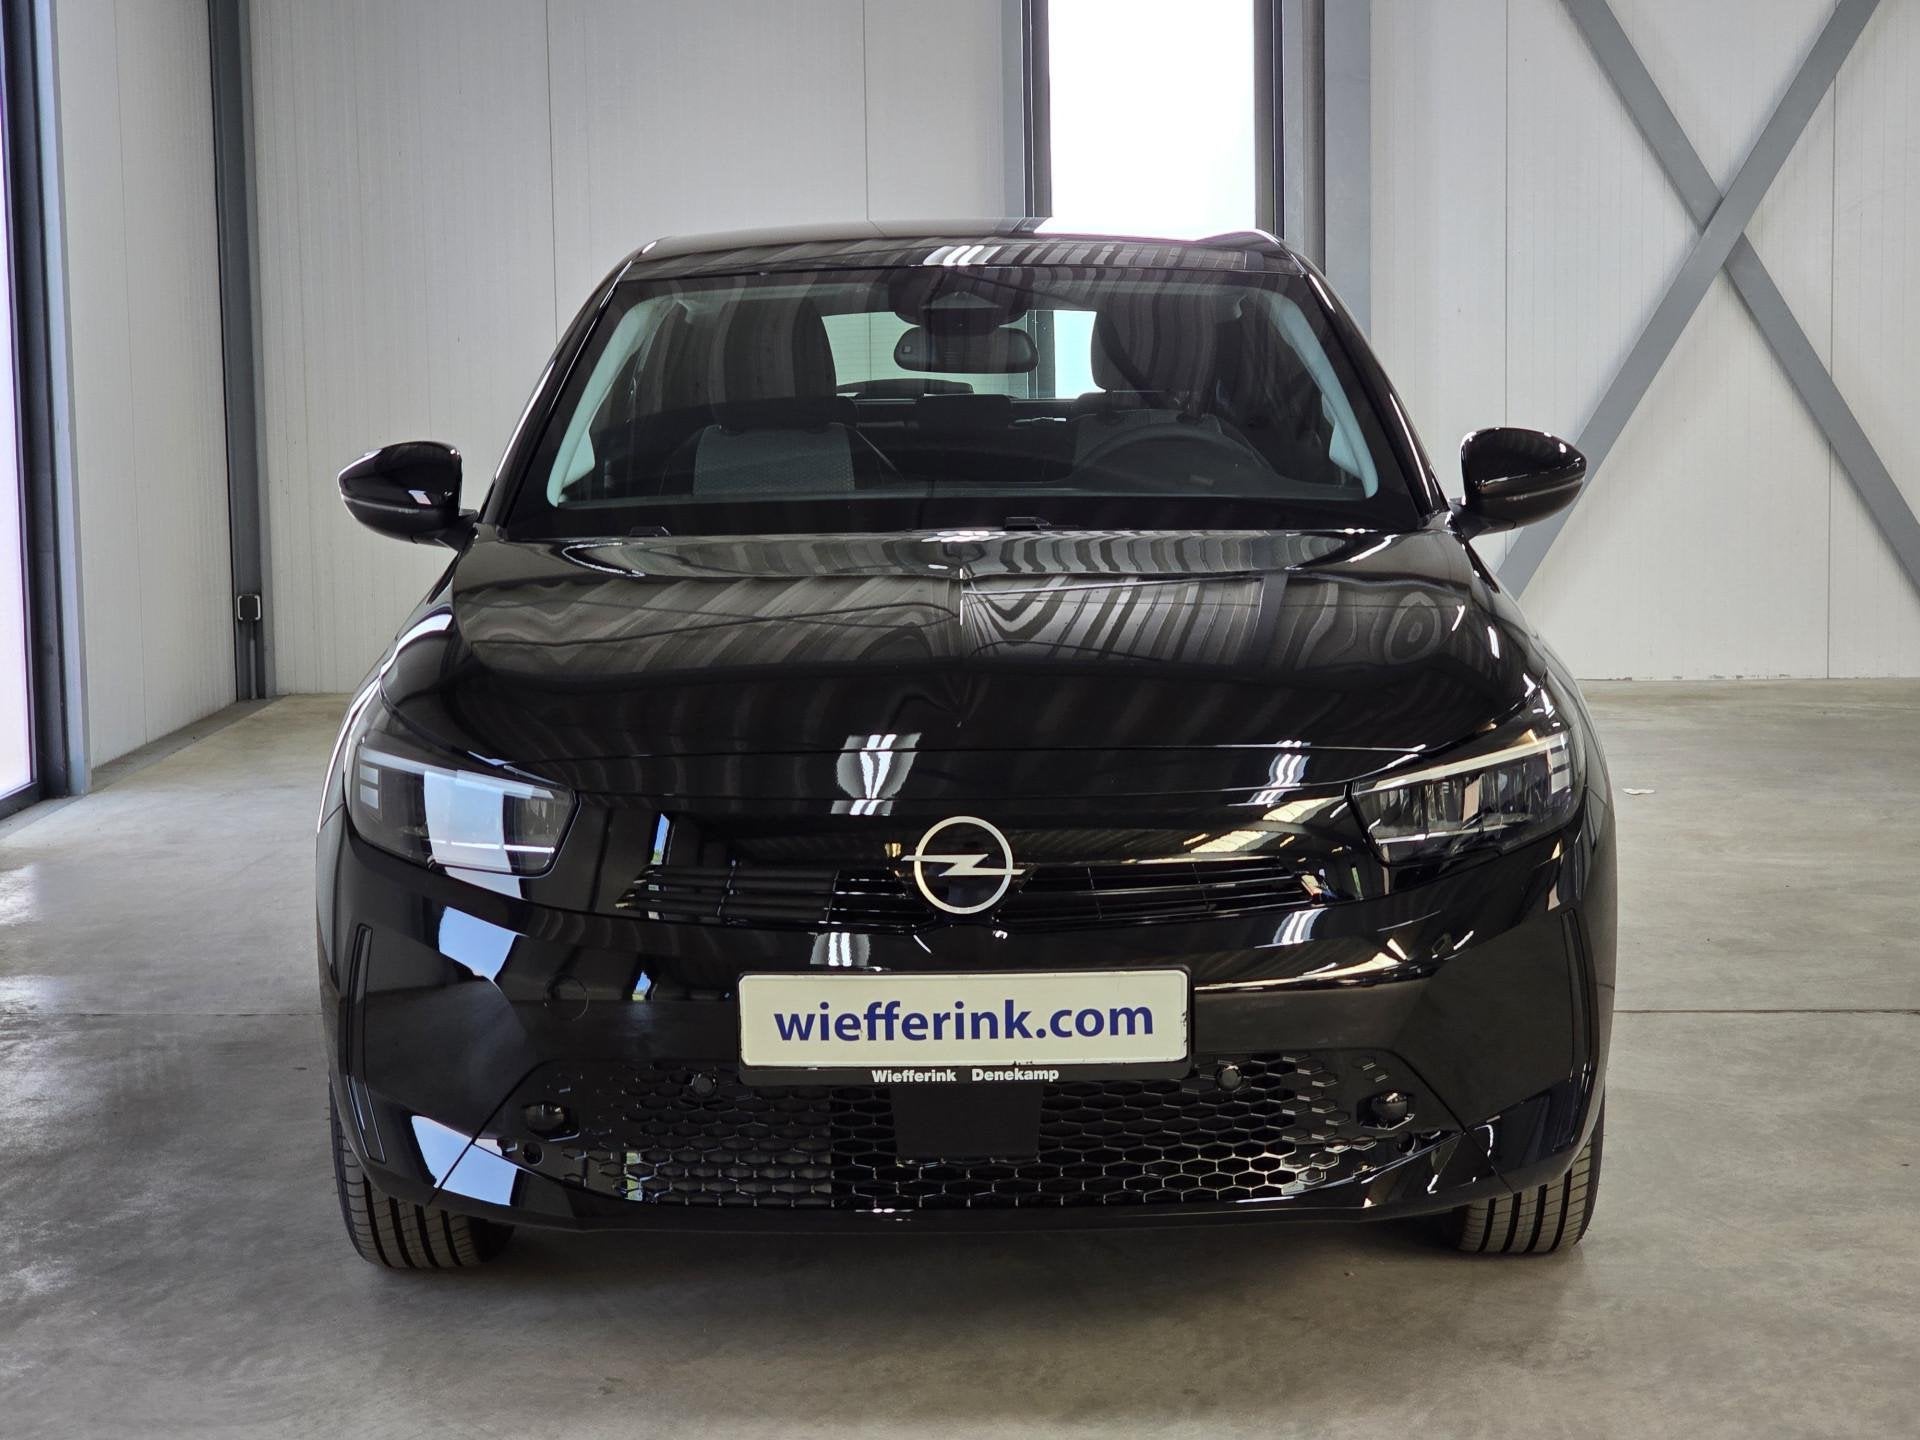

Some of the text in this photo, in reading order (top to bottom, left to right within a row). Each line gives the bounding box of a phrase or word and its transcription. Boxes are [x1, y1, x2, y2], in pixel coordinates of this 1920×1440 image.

[774, 1000, 1153, 1041] wiefferink.com
[871, 1067, 1060, 1083] Wiefferink Denekamp
